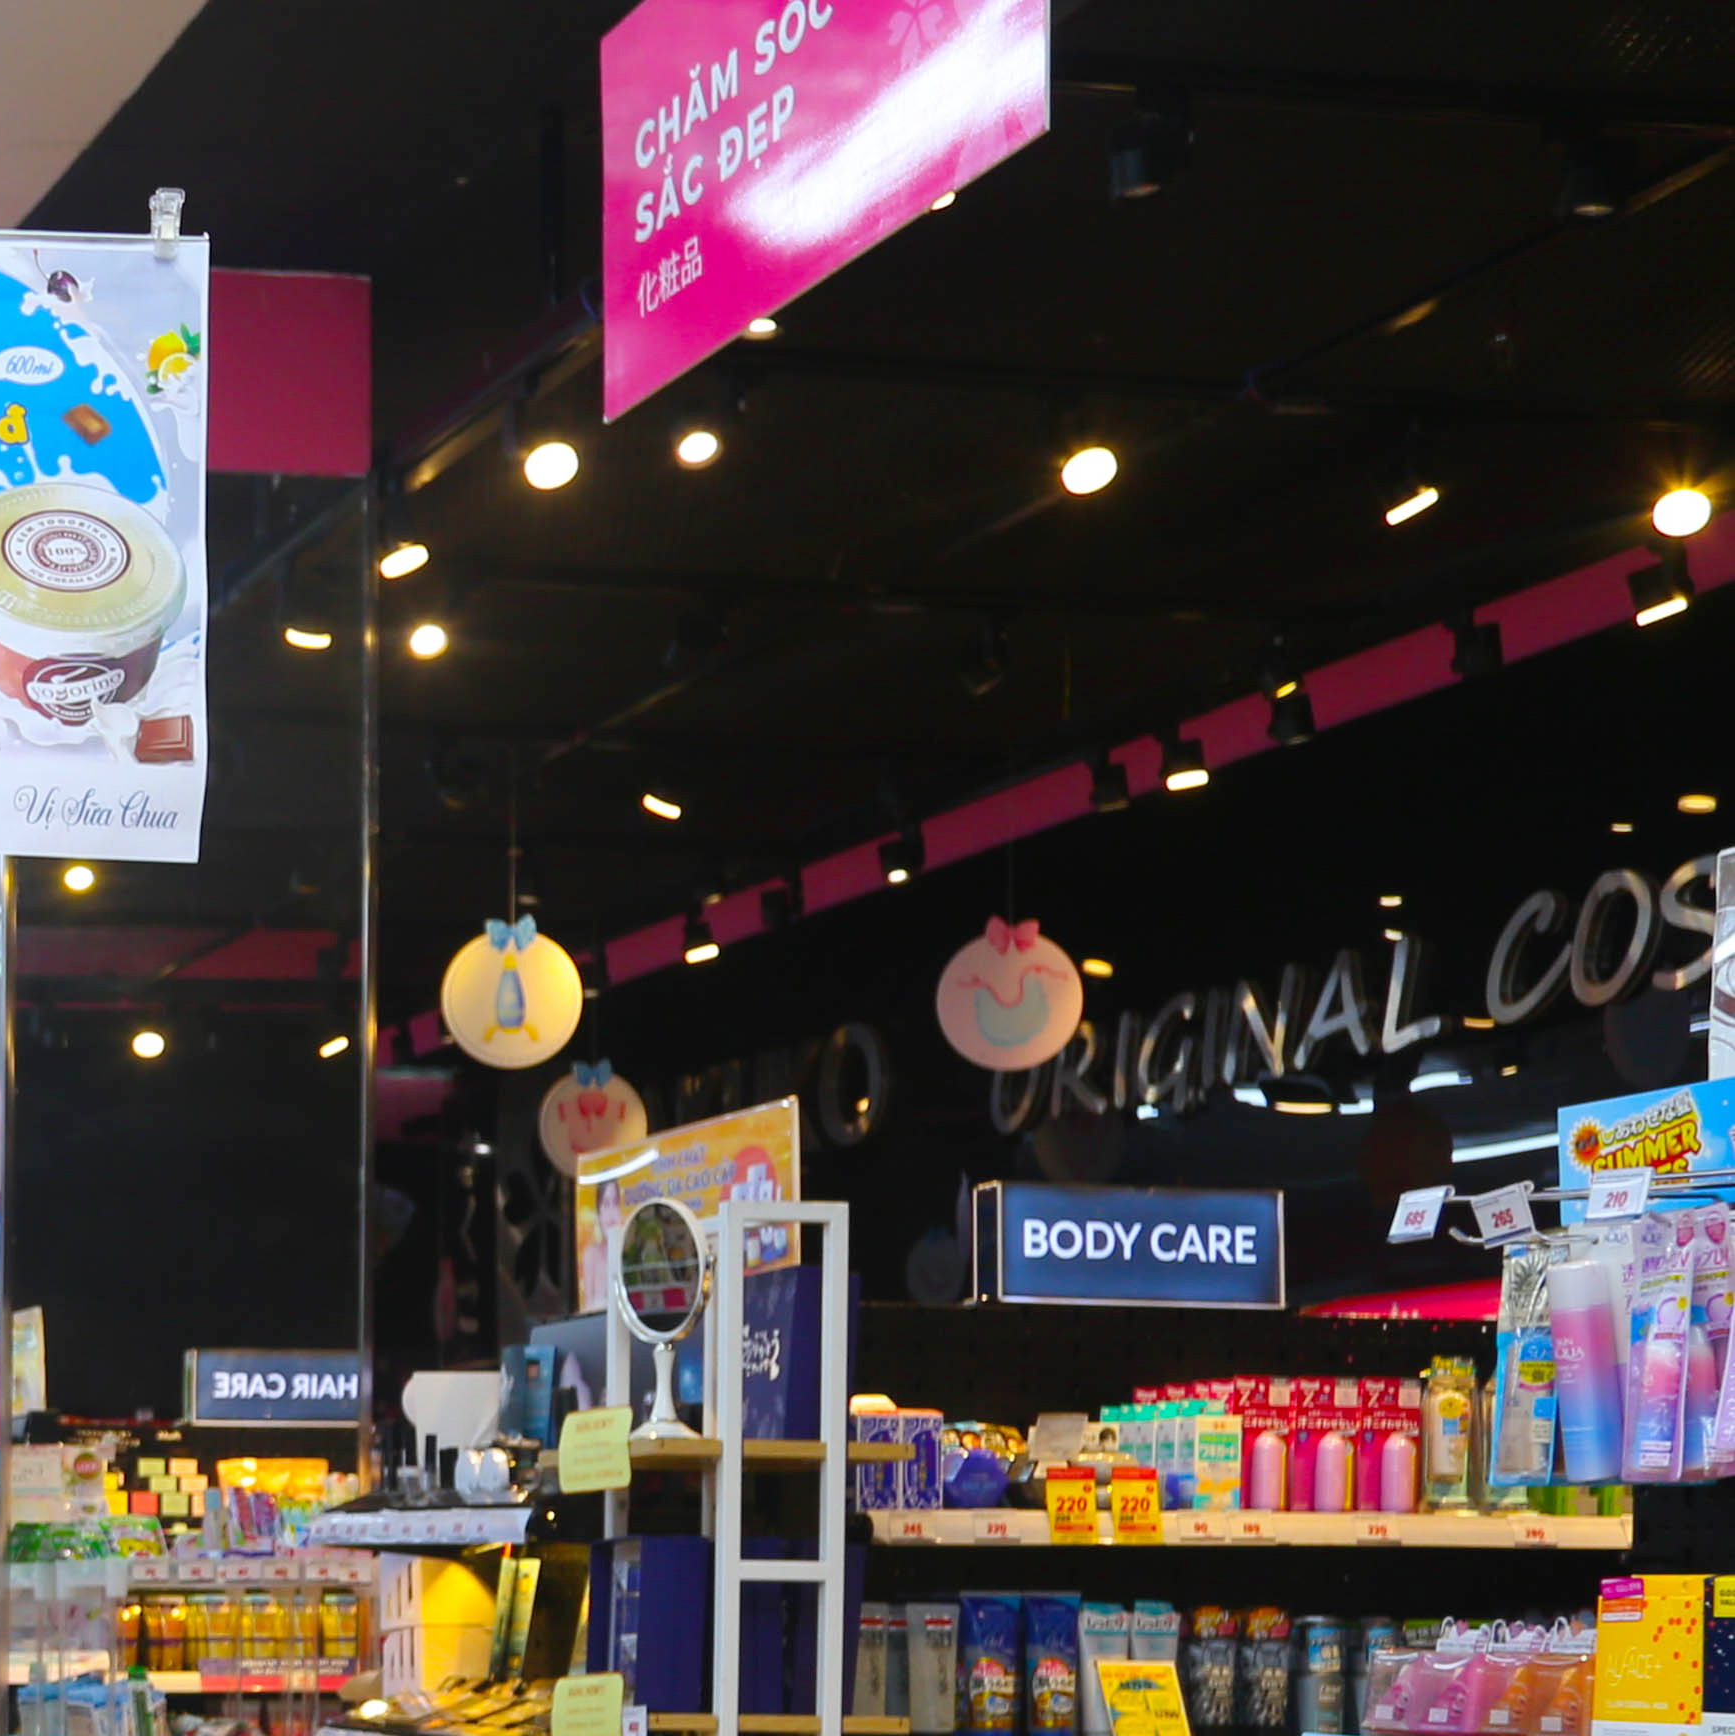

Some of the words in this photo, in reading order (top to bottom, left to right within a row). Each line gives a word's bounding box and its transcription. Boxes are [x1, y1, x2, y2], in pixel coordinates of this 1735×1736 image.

[635, 49, 738, 169] CHĂM
[718, 85, 795, 182] ĐẸP
[638, 236, 702, 317] 化粧品
[4, 353, 55, 378] 600ml
[121, 791, 179, 831] Chua
[1491, 1208, 1514, 1228] 265
[1603, 1190, 1628, 1208] 210
[1021, 1216, 1141, 1263] BODY
[1150, 1222, 1258, 1266] CARE
[1056, 1497, 1087, 1512] 220
